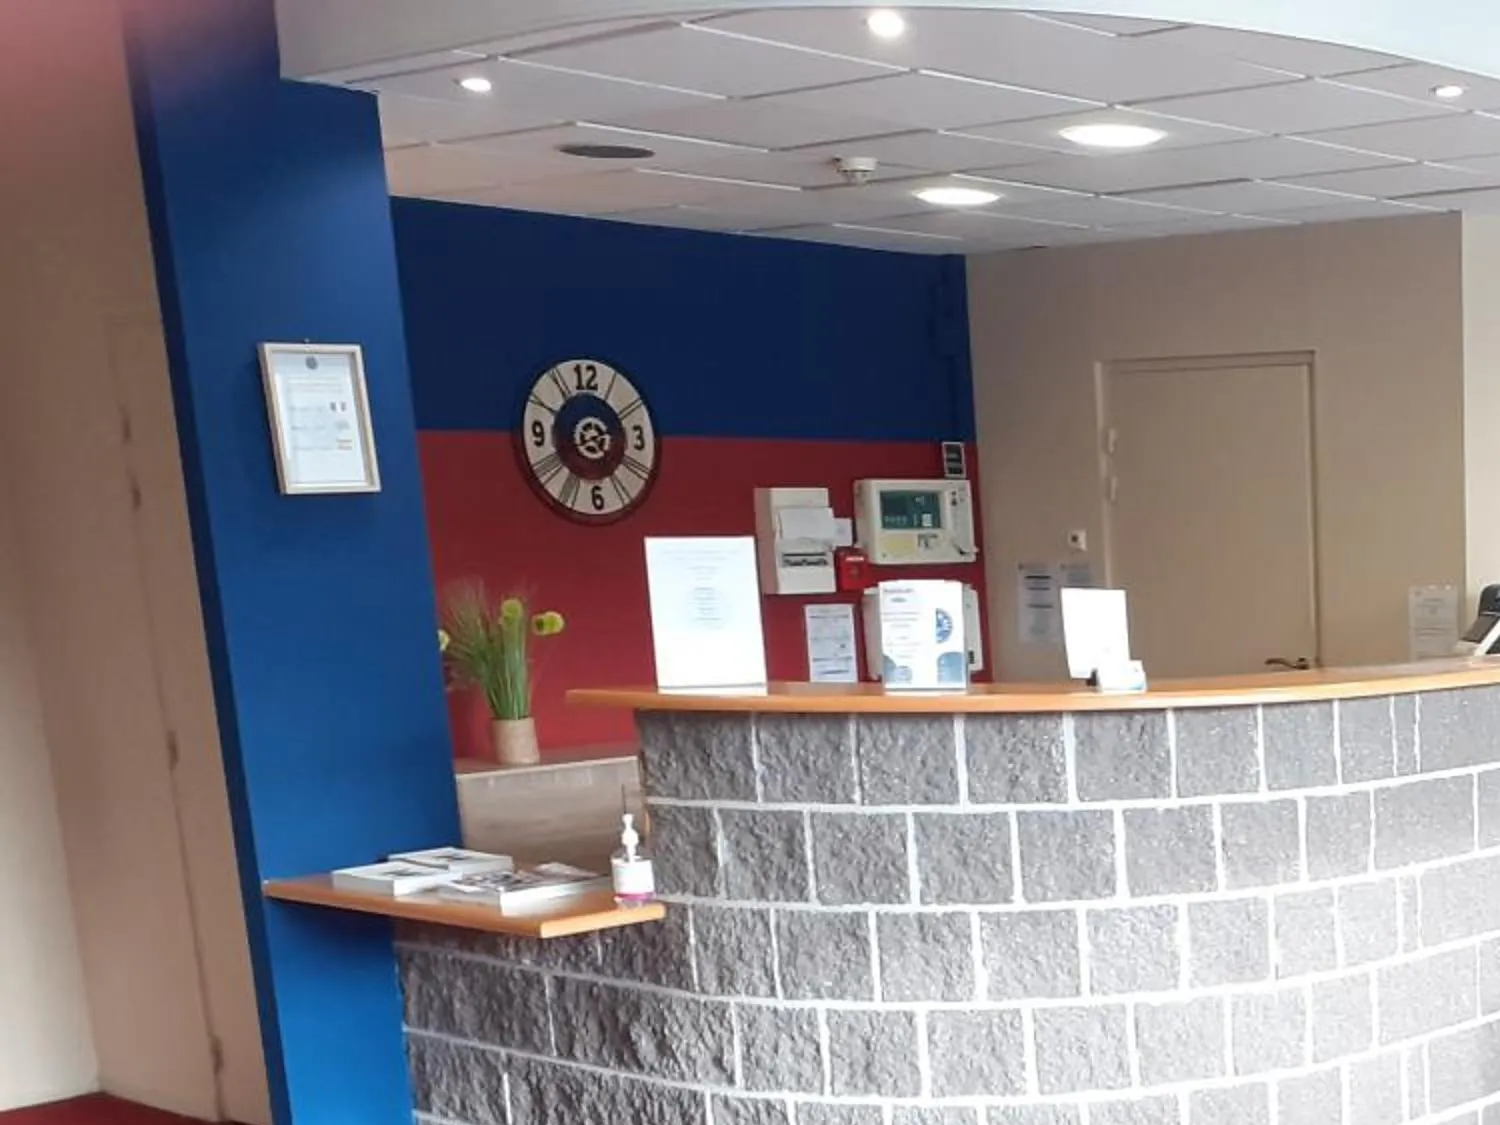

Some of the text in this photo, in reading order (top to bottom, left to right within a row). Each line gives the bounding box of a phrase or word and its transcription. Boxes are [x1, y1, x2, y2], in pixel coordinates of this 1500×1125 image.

[573, 364, 599, 391] 12
[531, 420, 545, 447] 9
[633, 425, 645, 450] 3
[590, 485, 605, 510] 6
